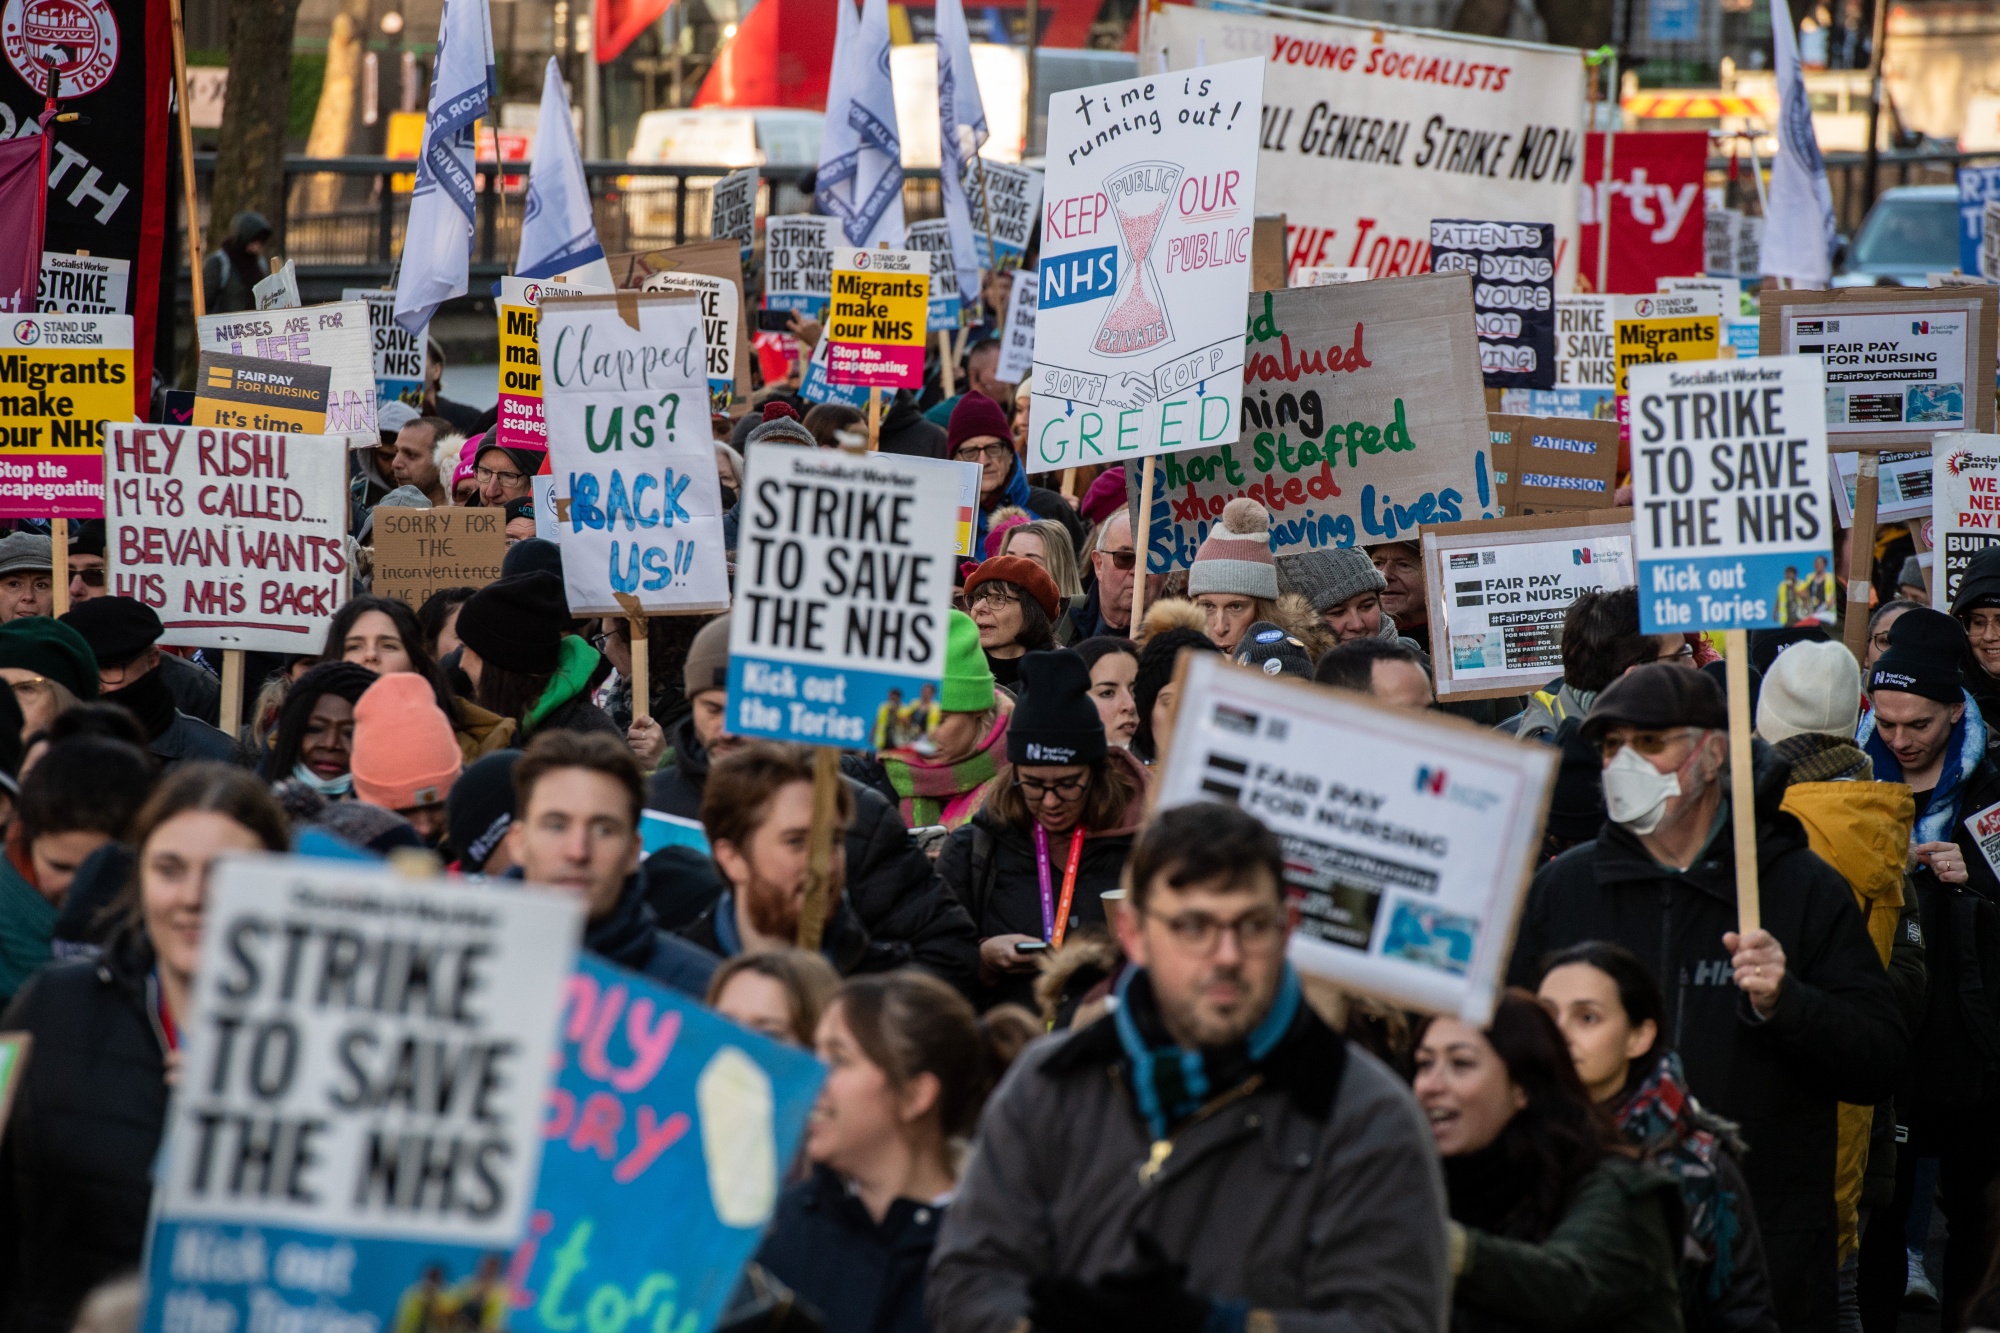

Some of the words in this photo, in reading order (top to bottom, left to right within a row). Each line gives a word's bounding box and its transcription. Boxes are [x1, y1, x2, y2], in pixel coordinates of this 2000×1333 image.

[1271, 33, 1358, 73] YOUNG
[71, 52, 113, 93] 1880
[1075, 82, 1156, 126] time
[1183, 77, 1212, 97] is
[1068, 109, 1163, 166] running
[1509, 124, 1579, 184] NOW
[1109, 167, 1180, 203] PUBLIC
[1178, 169, 1241, 216] OUR
[1046, 192, 1109, 243] KEEP
[770, 228, 826, 249] STRIKE
[1432, 227, 1540, 246] PATIENTS
[770, 250, 790, 269] TO
[796, 251, 834, 271] SAVE
[872, 254, 896, 263] STAND
[896, 255, 908, 263] UP
[1166, 226, 1251, 274] PUBLIC
[51, 257, 83, 270] Socialist
[83, 260, 109, 272] Worker
[872, 262, 884, 270] TO
[884, 262, 911, 271] RACISM
[1438, 255, 1478, 275] ARE
[1481, 257, 1552, 278] DYING
[770, 271, 800, 291] THE
[837, 274, 924, 300] Migrants
[1045, 252, 1114, 302] NHS
[835, 299, 889, 318] make
[1477, 287, 1550, 308] YOURE
[1656, 299, 1680, 308] STAND
[1682, 299, 1693, 307] UP
[1656, 307, 1667, 316] TO
[1668, 306, 1698, 315] RACISM
[43, 321, 78, 333] STAND
[82, 322, 97, 333] UP
[215, 320, 273, 342] NURSES
[283, 316, 311, 335] ARE
[318, 312, 344, 331] FOR
[834, 322, 867, 339] our
[872, 320, 914, 341] NHS
[1097, 321, 1168, 349] PRIVATE
[1477, 315, 1519, 334] NOT
[1620, 322, 1715, 350] Migrants
[44, 333, 58, 345] TO
[61, 333, 103, 345] RACISM
[1568, 335, 1615, 359] SAVE
[1827, 342, 1864, 354] FAIR
[1868, 341, 1900, 352] PAY
[383, 352, 422, 377] NHS
[553, 322, 698, 391] Clapped
[832, 345, 860, 361] Stop
[861, 346, 882, 360] the
[1827, 354, 1860, 366] FOR
[1864, 351, 1938, 364] NURSING
[237, 369, 266, 383] FAIR
[268, 374, 295, 387] PAY
[831, 359, 909, 377] scapegoating
[1669, 371, 1729, 387] Socialist
[1731, 367, 1782, 384] Worker
[1829, 370, 1935, 382] #FairPayForNursing
[236, 380, 261, 394] FOR
[264, 385, 321, 401] NURSING
[503, 398, 534, 419] Stop
[1641, 387, 1786, 444] STRIKE
[252, 413, 304, 434] time
[1039, 395, 1231, 464] GREED
[114, 427, 186, 476] HEY
[1531, 435, 1596, 454] PATIENTS
[37, 461, 68, 478] the
[1641, 447, 1692, 496] TO
[1711, 440, 1811, 492] SAVE
[1521, 472, 1606, 492] PROFESSION
[1969, 477, 1997, 493] WE
[113, 477, 184, 517] 1948
[569, 466, 691, 533] BACK
[384, 514, 451, 533] SORRY
[465, 514, 496, 533] FOR
[754, 478, 917, 547] STRIKE
[1643, 499, 1722, 548] THE
[1737, 491, 1821, 544] NHS
[1958, 513, 1994, 528] PAY
[119, 525, 230, 567] BEVAN
[237, 530, 347, 575] WANTS
[416, 537, 456, 557] THE
[382, 563, 501, 580] inconvenience
[609, 539, 695, 594] US!!
[750, 535, 803, 591] TO
[822, 545, 935, 608] SAVE
[1652, 565, 1702, 593] Kick
[1708, 564, 1746, 590] out
[1485, 577, 1524, 591] FAIR
[1528, 573, 1562, 588] PAY
[183, 579, 248, 616] NHS
[259, 577, 338, 621] BACK!
[1486, 591, 1521, 605] FOR
[1654, 601, 1692, 627] the
[1697, 596, 1768, 627] Tories
[744, 592, 834, 652] THE
[845, 603, 935, 663] NHS
[1518, 630, 1549, 638] NURSING.
[1522, 660, 1554, 668] PATIENTS.
[741, 662, 797, 696] Kick
[801, 676, 848, 705] out
[739, 697, 784, 733] the
[789, 702, 865, 742] Tories
[1254, 763, 1321, 796] FAIR
[1328, 781, 1386, 812] PAY
[1250, 789, 1308, 819] FOR
[1314, 806, 1449, 858] NURSING
[219, 911, 494, 1028] STRIKE
[207, 1011, 300, 1102] TO
[329, 1026, 518, 1124] SAVE
[191, 1109, 324, 1206] THE
[352, 1124, 512, 1221] NHS
[170, 1226, 267, 1284] Kick
[274, 1243, 356, 1294] out
